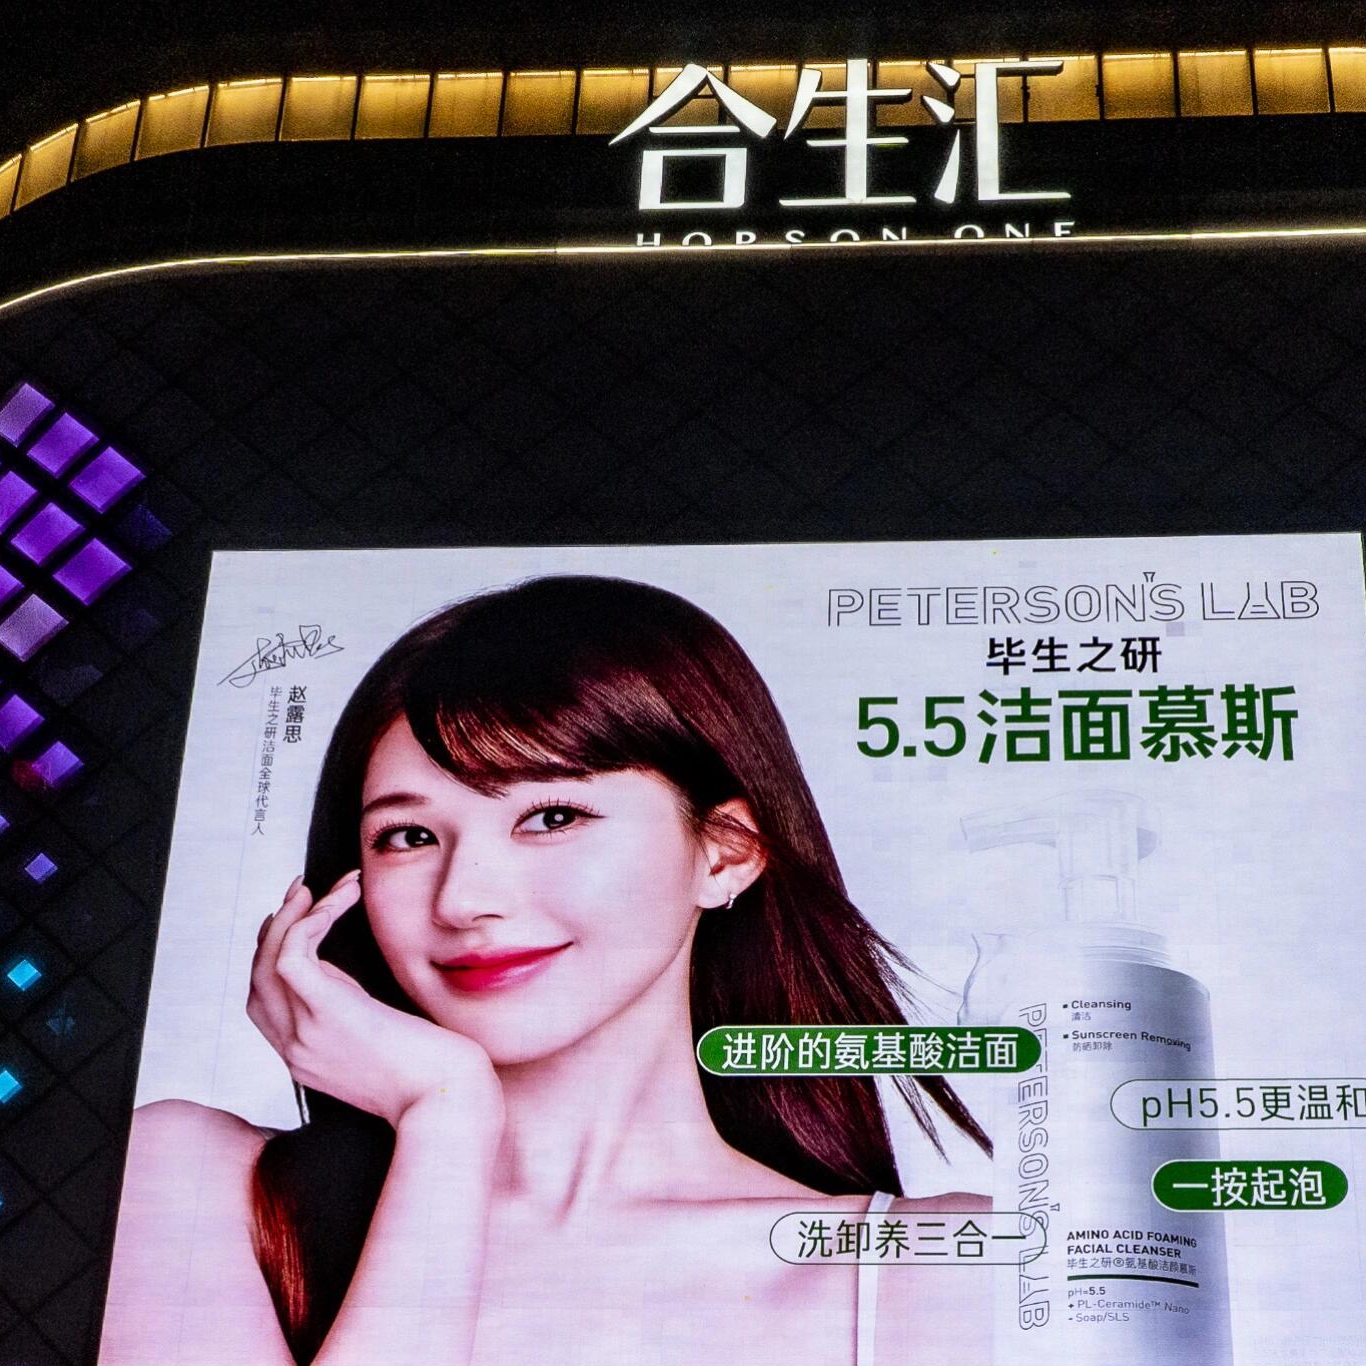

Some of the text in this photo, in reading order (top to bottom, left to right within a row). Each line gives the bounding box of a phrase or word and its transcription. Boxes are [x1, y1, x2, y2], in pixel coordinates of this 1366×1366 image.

[608, 59, 1072, 210] 合生汇
[827, 571, 1320, 628] PETERSON'S LAB
[986, 636, 1162, 676] 毕生之研
[282, 684, 308, 744] 赵露思
[856, 684, 1299, 764] 5.5洁面慕斯
[251, 686, 283, 837] 毕生之研洁面全球代言人
[1071, 1000, 1132, 1011] Cleansing
[721, 1032, 1019, 1070] 进阶的氨基酸洁面
[1072, 1030, 1192, 1052] Sunscreen Removing
[1172, 1166, 1327, 1208] 一按起泡
[796, 1218, 1027, 1260] 洗卸养三合一
[1067, 1229, 1197, 1248] AMINO ACID FOAMING
[1067, 1243, 1181, 1259] FACIAL CLEANSER
[1068, 1286, 1106, 1299] pH=5.5
[1164, 1302, 1190, 1315] Nano
[1075, 1311, 1130, 1323] Soap/SLS
